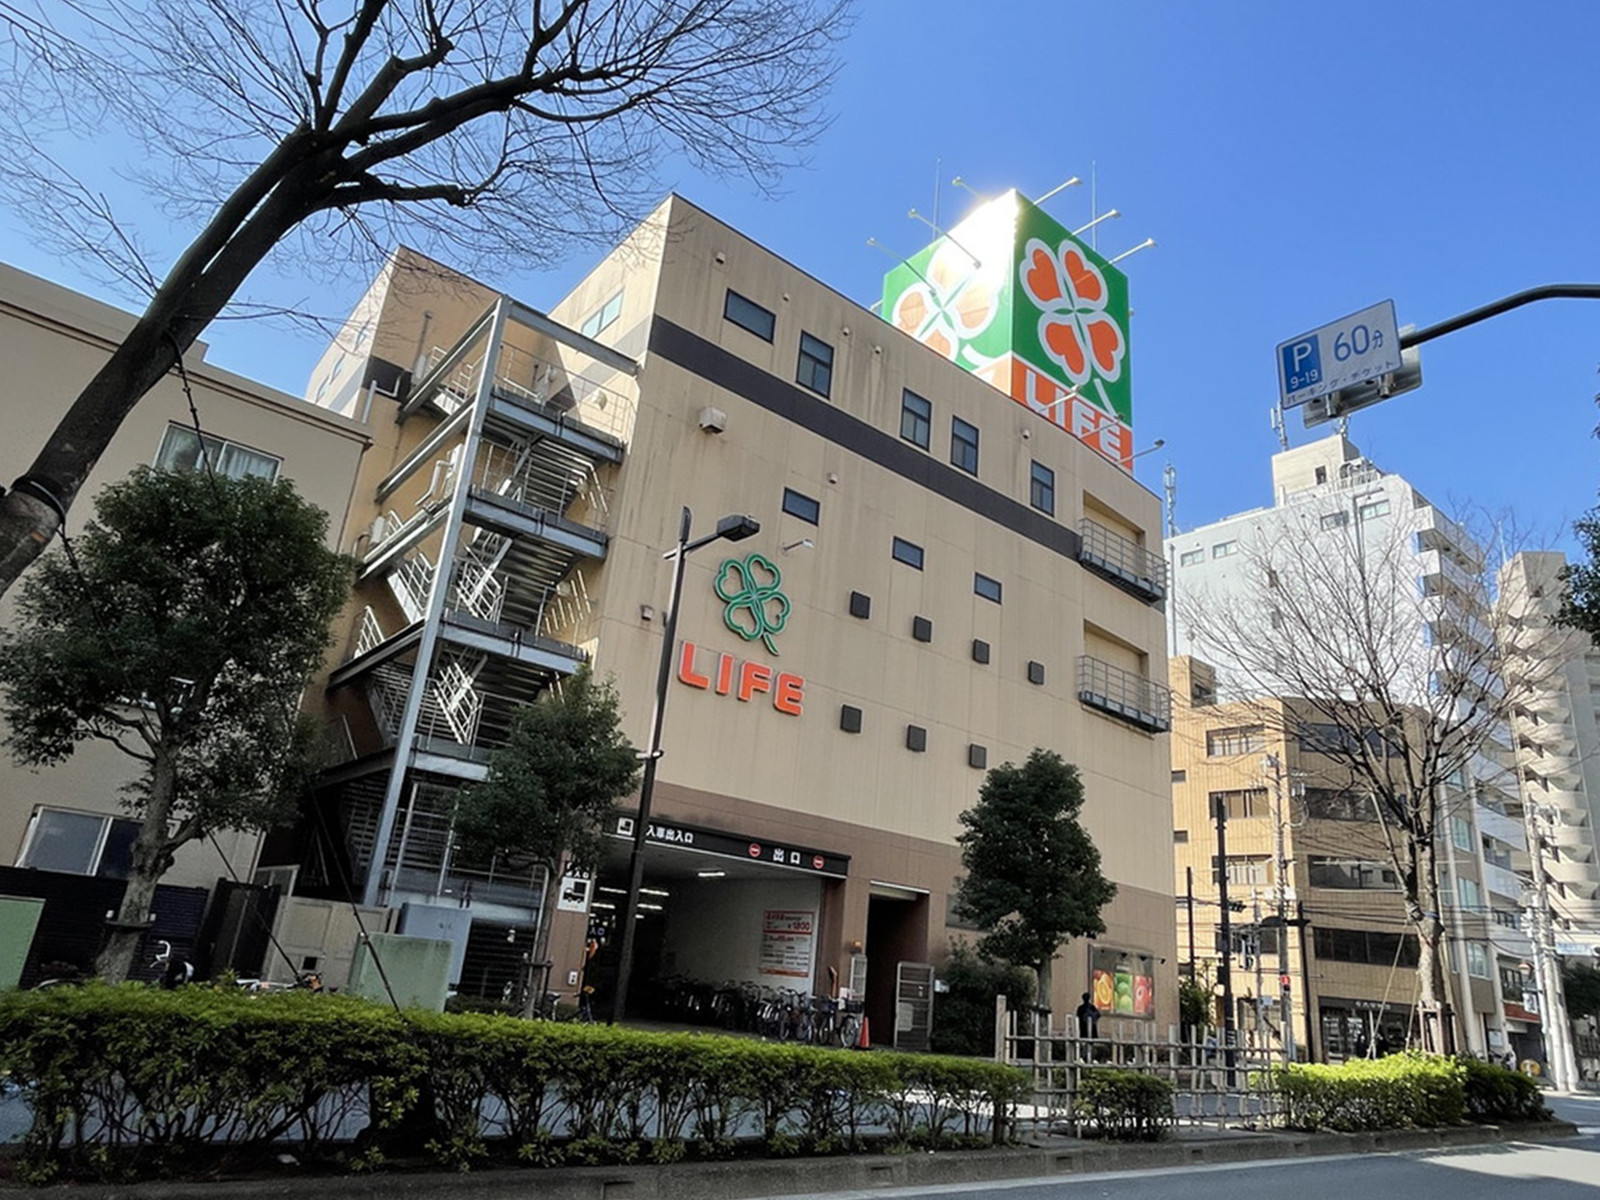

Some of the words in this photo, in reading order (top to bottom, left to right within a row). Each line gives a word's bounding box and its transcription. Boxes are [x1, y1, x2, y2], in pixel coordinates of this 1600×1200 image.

[1293, 342, 1311, 372] P
[1334, 324, 1383, 362] 60分
[1290, 369, 1318, 389] 9-19
[1026, 370, 1120, 460] LIFE
[678, 641, 805, 715] LIFE
